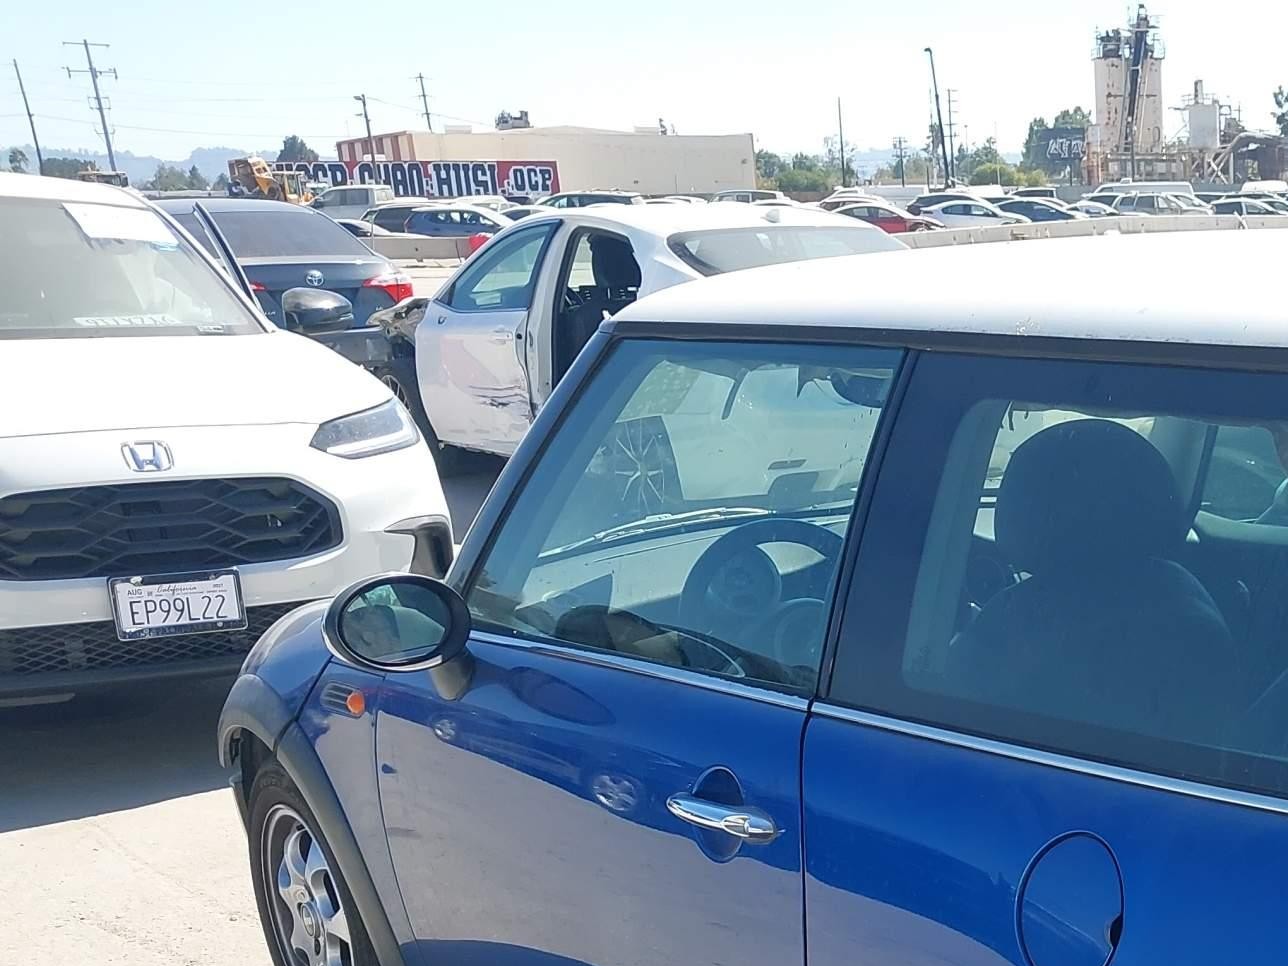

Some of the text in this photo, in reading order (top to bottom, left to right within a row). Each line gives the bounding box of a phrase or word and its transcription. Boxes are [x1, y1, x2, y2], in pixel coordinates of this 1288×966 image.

[127, 588, 143, 596] AUG
[156, 585, 197, 596] California
[129, 594, 228, 626] EP99L22
